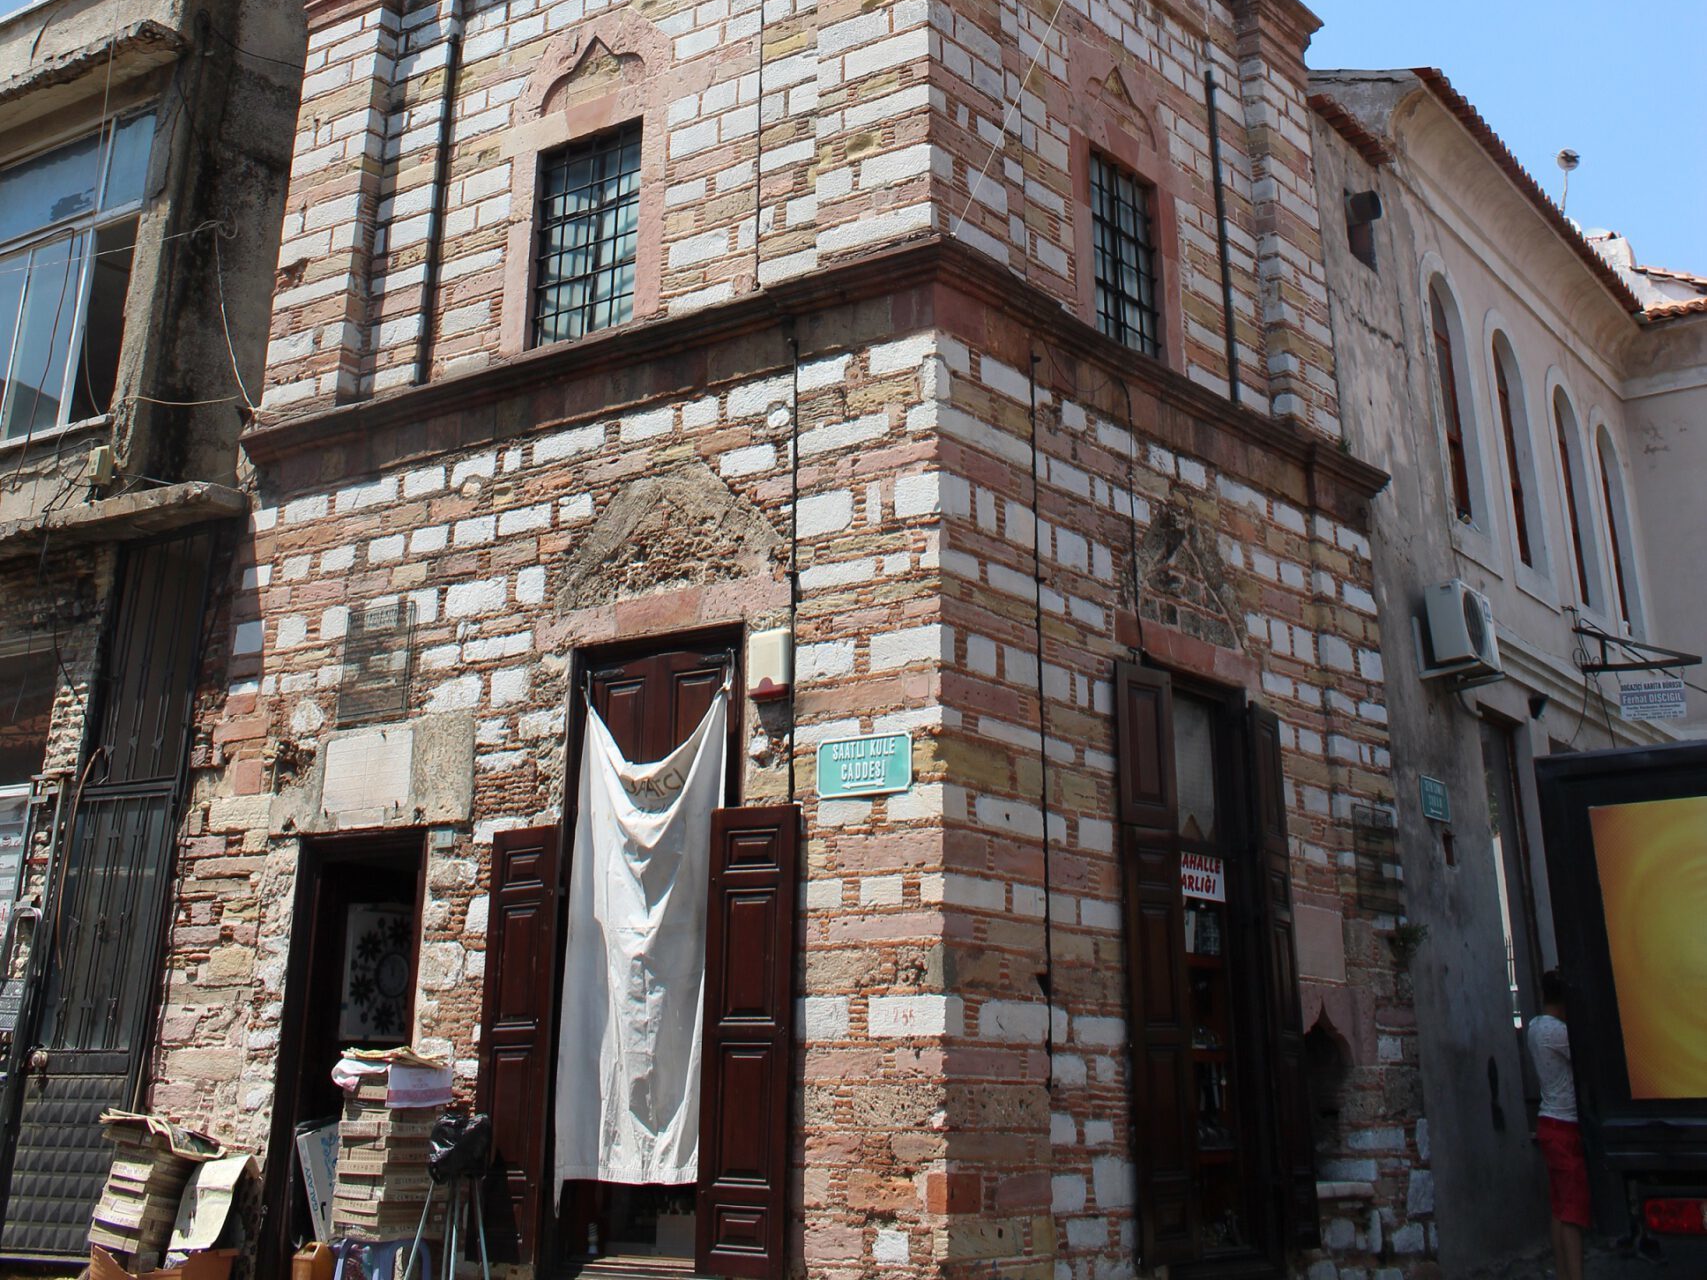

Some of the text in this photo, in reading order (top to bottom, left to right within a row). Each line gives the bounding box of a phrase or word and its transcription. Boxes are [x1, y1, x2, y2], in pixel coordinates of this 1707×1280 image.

[870, 737, 896, 756] KULE
[1182, 853, 1221, 874] AHALLE
[1181, 873, 1216, 895] ARLIĞI
[304, 1167, 319, 1212] GALAXY
